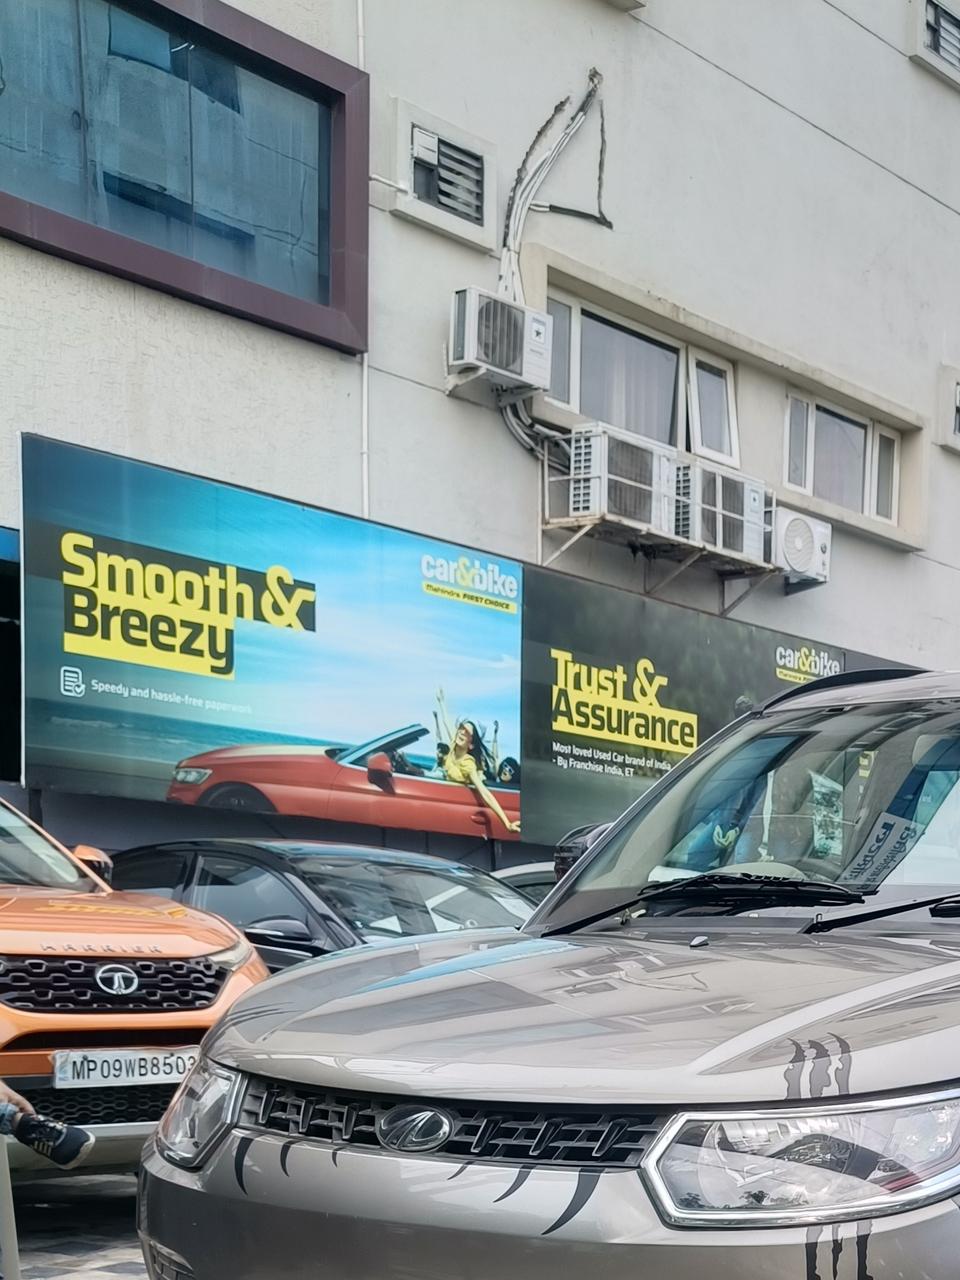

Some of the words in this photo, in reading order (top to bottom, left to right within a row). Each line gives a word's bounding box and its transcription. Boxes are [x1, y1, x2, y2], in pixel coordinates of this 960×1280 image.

[61, 532, 253, 621] Smooth
[261, 565, 316, 632] &
[421, 554, 518, 598] car&bike
[463, 593, 484, 604] FIRST
[484, 598, 510, 610] CHOICE
[64, 586, 234, 675] Breezy
[550, 648, 627, 699] Trust
[633, 657, 669, 708] &
[776, 646, 840, 677] car&bike
[91, 679, 129, 698] Speedy
[130, 687, 149, 698] and
[151, 689, 203, 708] hassle-free
[552, 687, 694, 748] Assurance
[552, 741, 572, 754] Most
[572, 744, 592, 757] loved
[593, 748, 612, 761] Used
[612, 752, 625, 763] Car
[625, 754, 645, 767] brand
[646, 758, 654, 767] of
[557, 755, 568, 769] By
[569, 757, 603, 772] Franchise
[624, 767, 634, 777] ET
